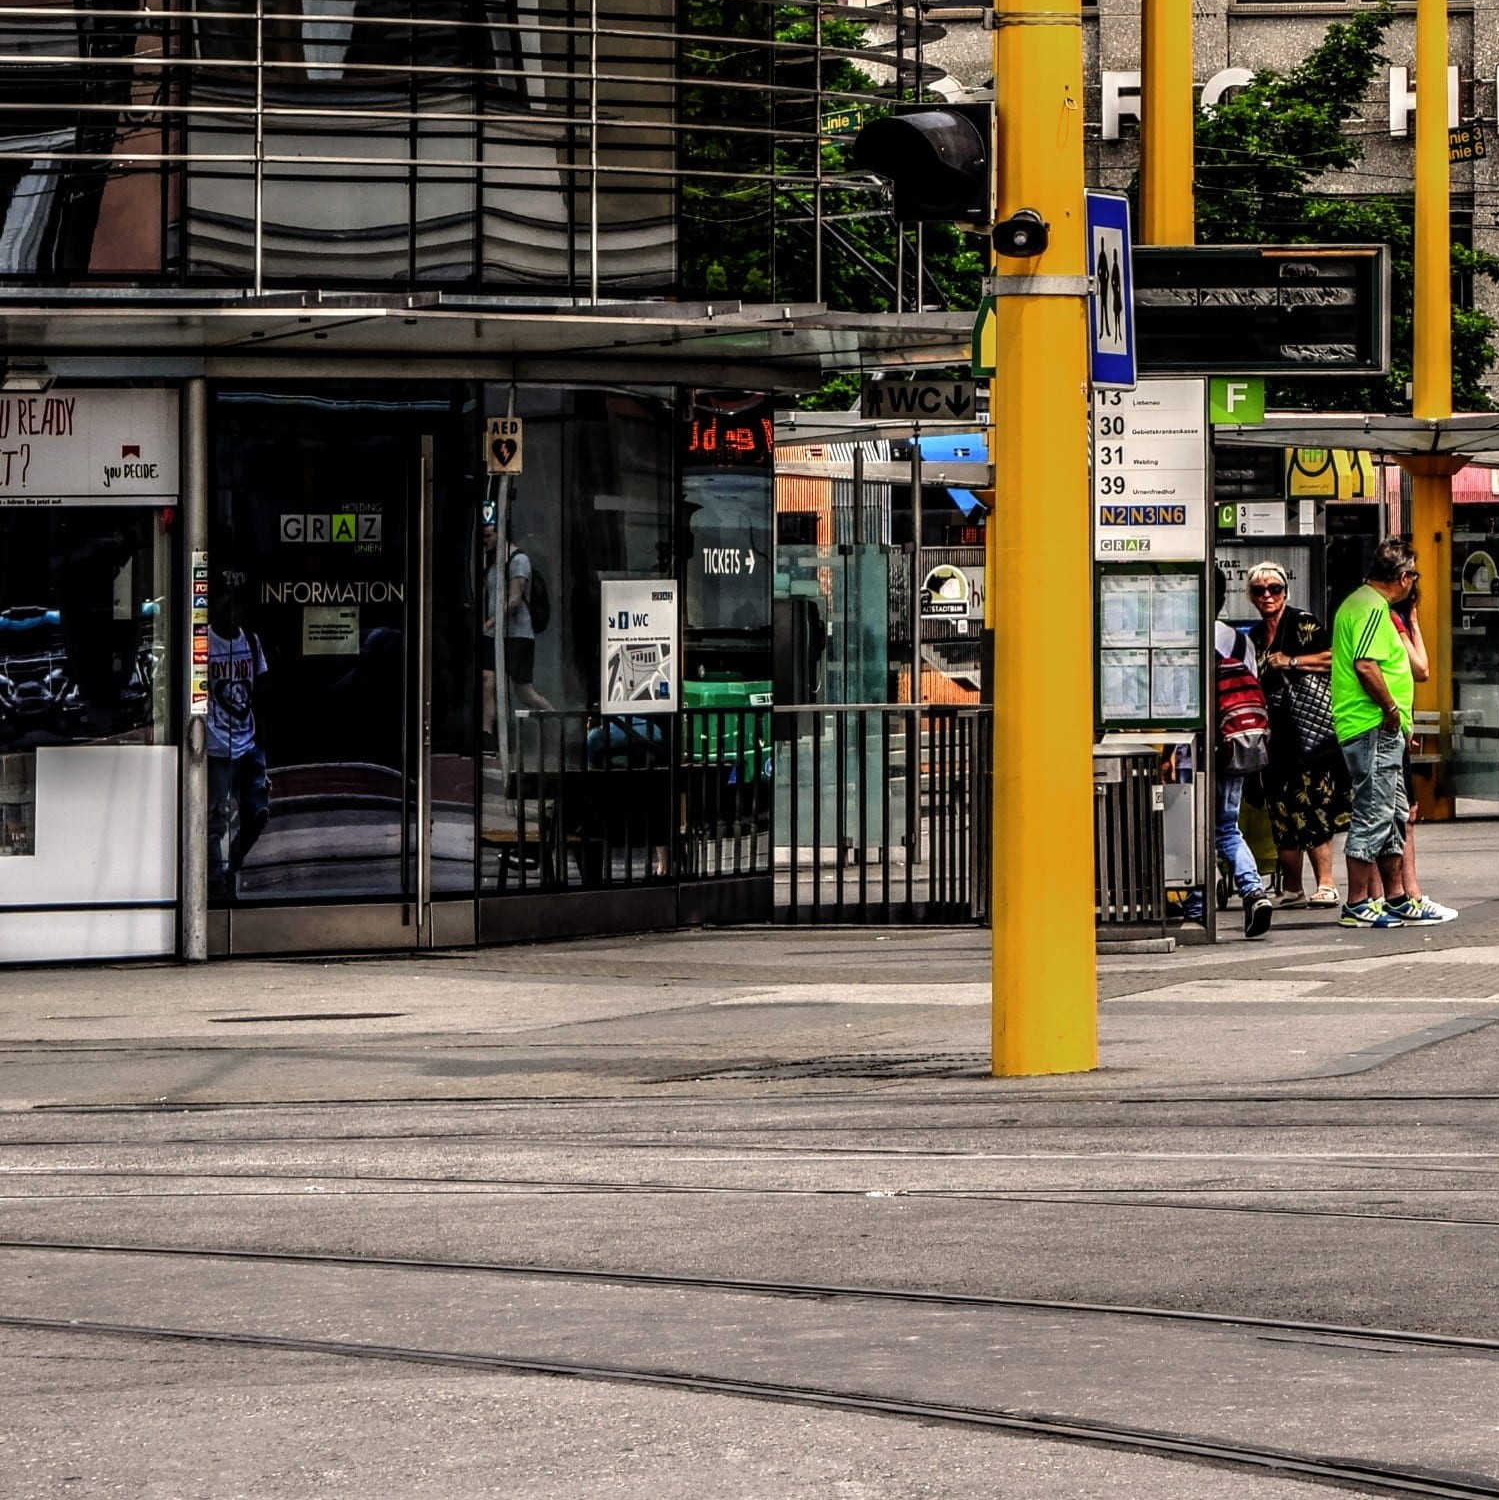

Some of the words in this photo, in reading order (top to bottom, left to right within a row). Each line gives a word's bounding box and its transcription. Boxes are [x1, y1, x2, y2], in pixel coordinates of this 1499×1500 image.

[821, 115, 850, 131] Linie
[1473, 127, 1482, 140] 3
[1475, 142, 1484, 155] 6
[887, 386, 941, 413] WC
[1098, 390, 1122, 406] 13
[1227, 383, 1248, 413] F
[18, 398, 75, 436] READY
[492, 421, 518, 435] AED
[1100, 416, 1125, 436] 30
[1101, 446, 1124, 465] 31
[1133, 459, 1159, 467] Webling
[103, 465, 122, 487] you
[1101, 476, 1125, 495] 39
[1132, 488, 1176, 496] Urnenfriedhof
[342, 503, 382, 512] HOLDING
[1101, 506, 1127, 524] N2
[1130, 506, 1156, 524] N3
[1159, 506, 1185, 524] N6
[1223, 506, 1232, 522] C
[1240, 506, 1247, 517] 3
[282, 515, 381, 541] GRAZ
[1240, 523, 1247, 533] 6
[355, 544, 382, 553] LINIEN
[1101, 540, 1150, 551] GRAZ
[703, 548, 740, 574] TICKETS
[261, 581, 404, 603] INFORMATION
[632, 613, 649, 627] WC
